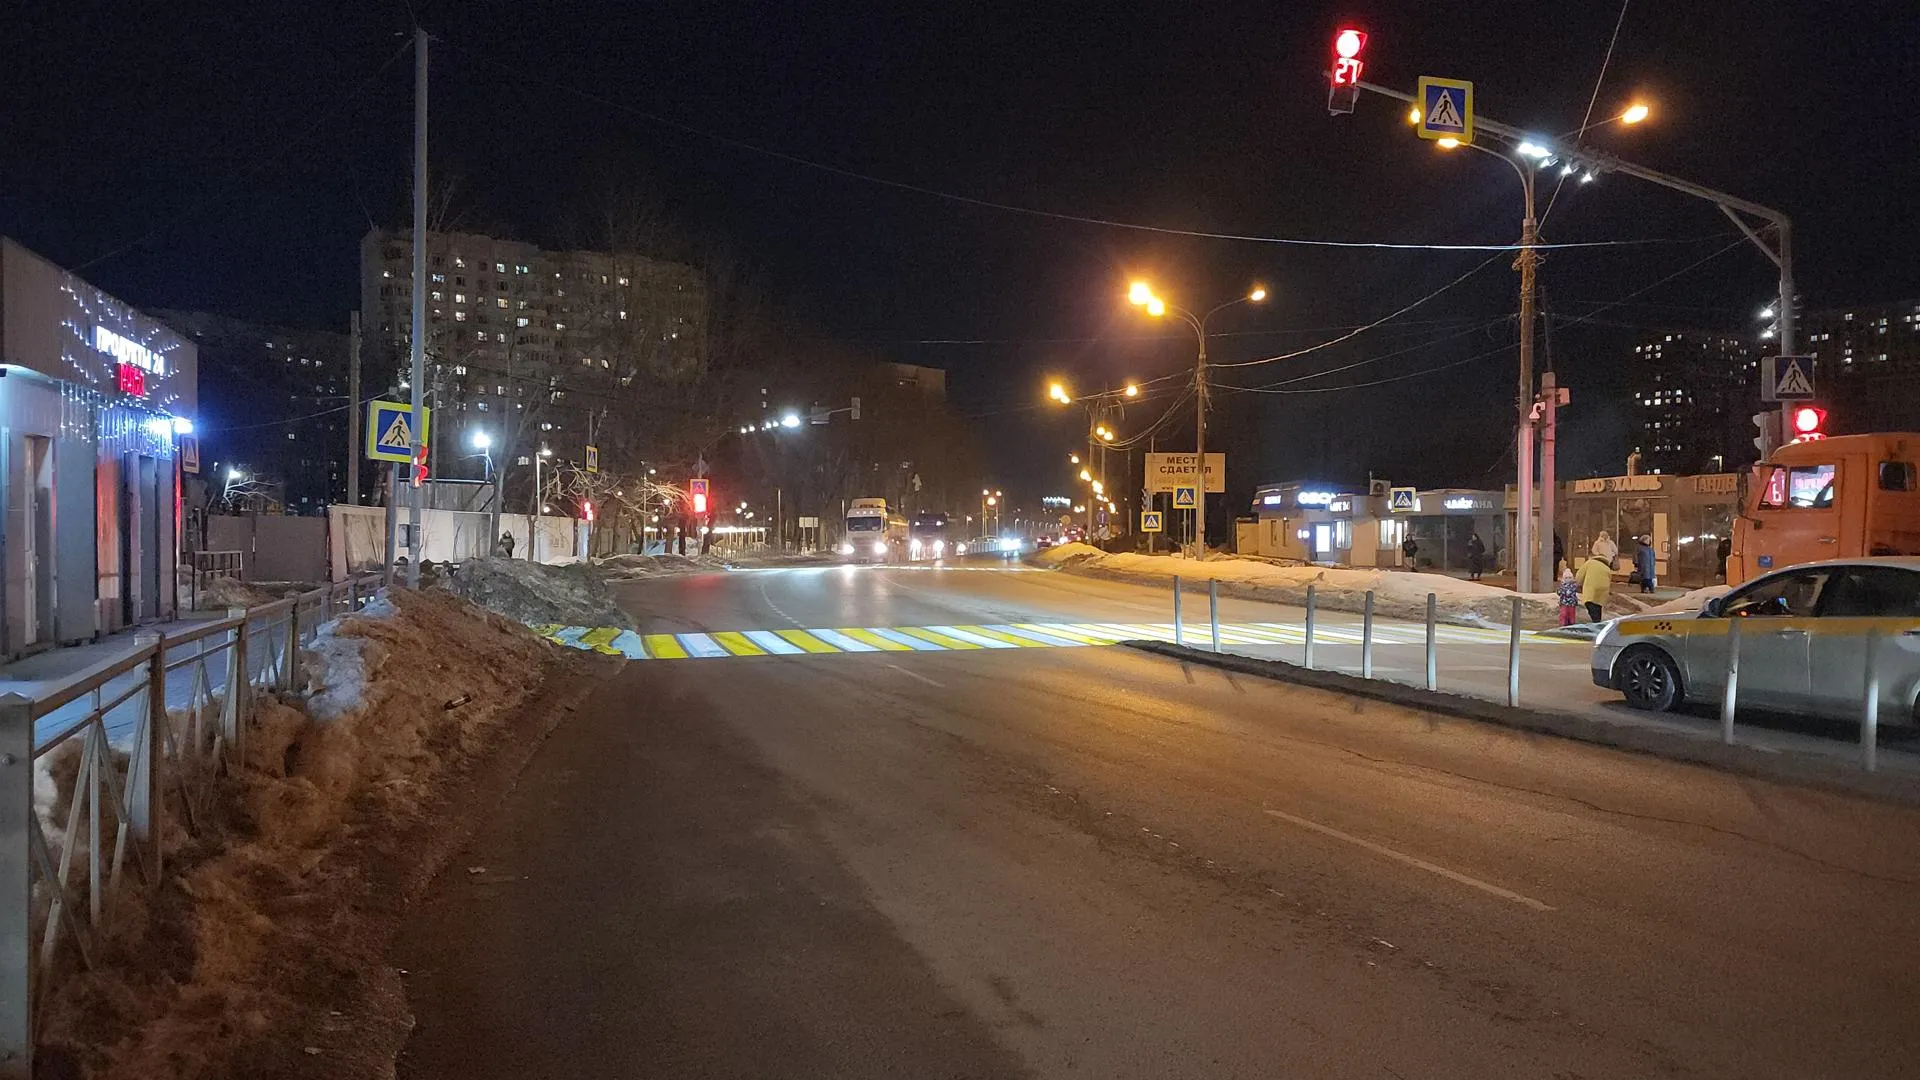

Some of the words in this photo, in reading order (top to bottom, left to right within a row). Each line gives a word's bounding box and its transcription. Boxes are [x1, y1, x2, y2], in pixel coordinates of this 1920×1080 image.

[1335, 57, 1357, 84] 27
[1160, 466, 1211, 474] СДАЕТЯ
[1444, 497, 1493, 509] ЧАЙХАНА
